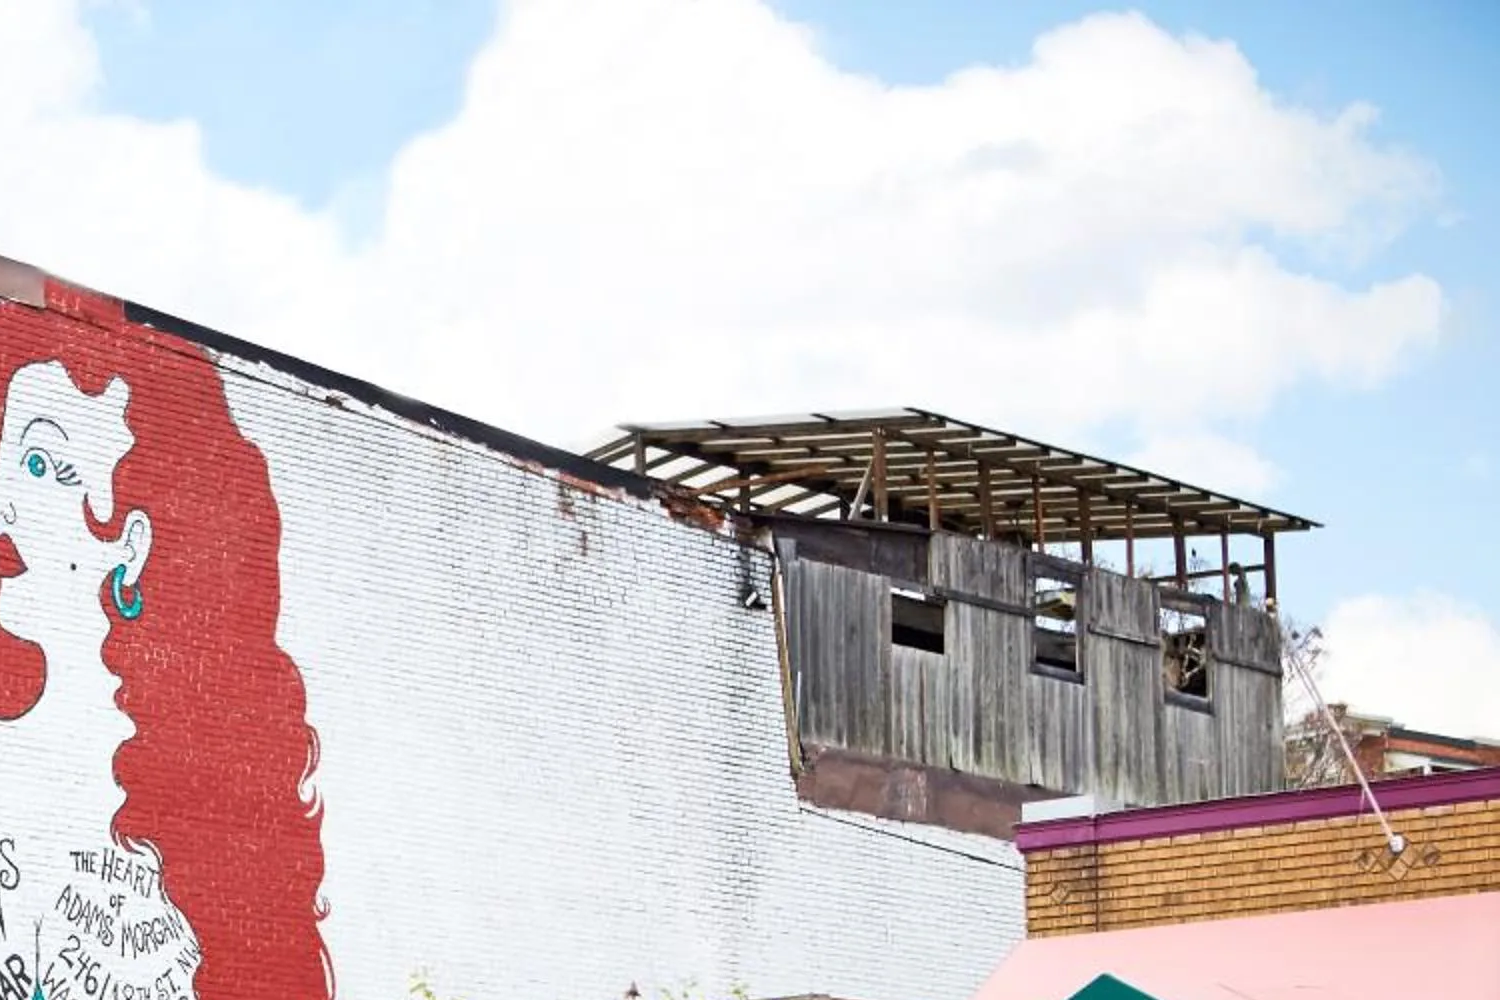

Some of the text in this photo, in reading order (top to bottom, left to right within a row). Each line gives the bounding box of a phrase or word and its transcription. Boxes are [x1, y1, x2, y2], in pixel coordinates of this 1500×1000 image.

[69, 848, 161, 899] THE HEART
[54, 883, 185, 960] ADAMS MORGAN
[109, 894, 127, 917] OF
